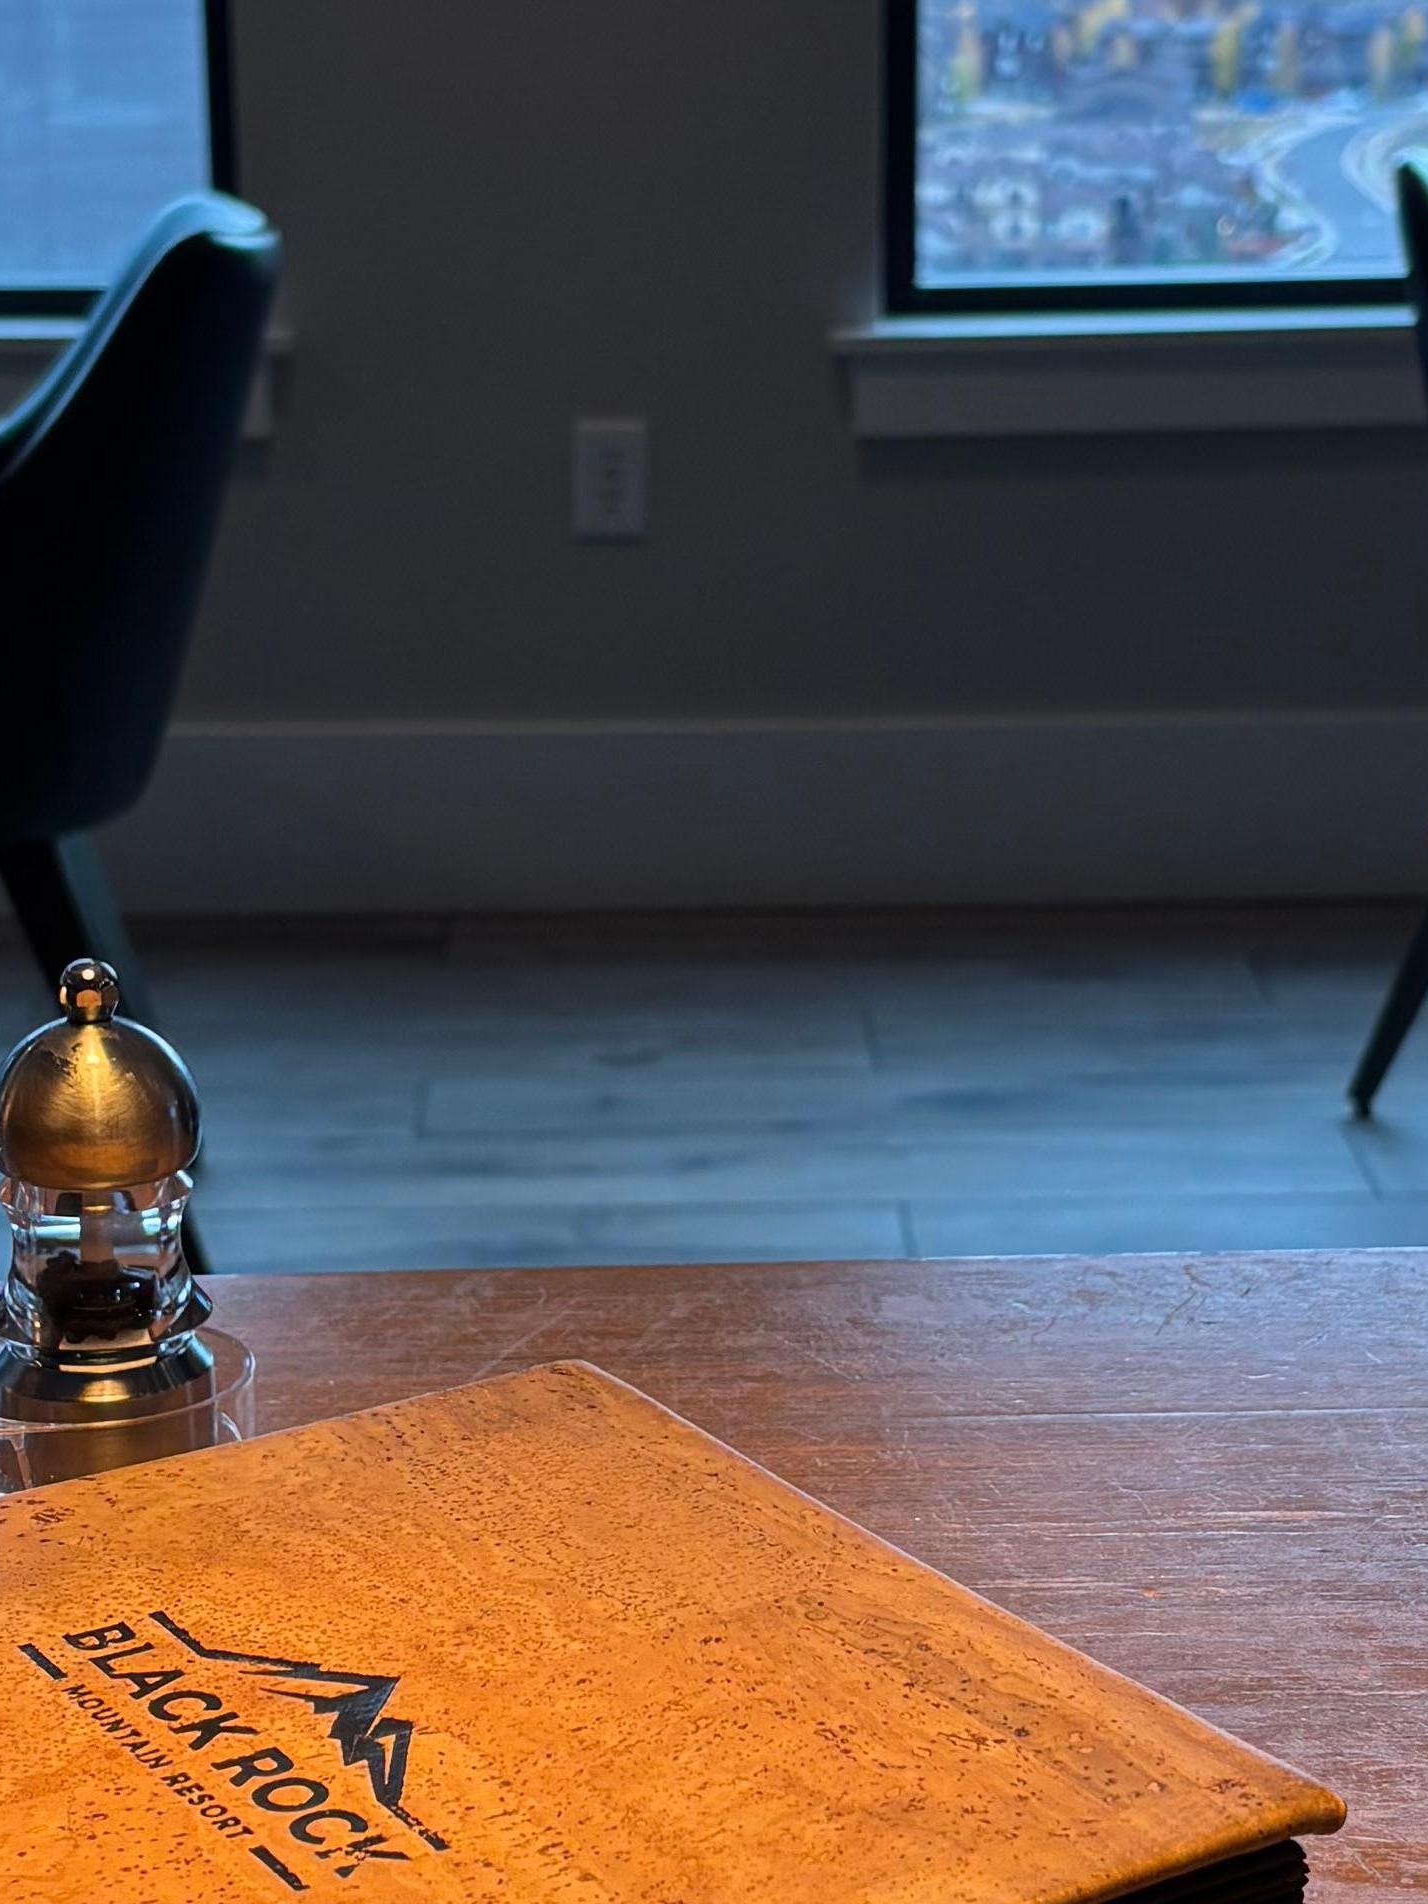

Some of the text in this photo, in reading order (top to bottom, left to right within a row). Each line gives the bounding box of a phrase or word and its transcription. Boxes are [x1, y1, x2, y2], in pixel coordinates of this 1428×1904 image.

[62, 1622, 411, 1879] BLACK ROCK
[62, 1683, 255, 1839] MOUNTAIN RESORT
